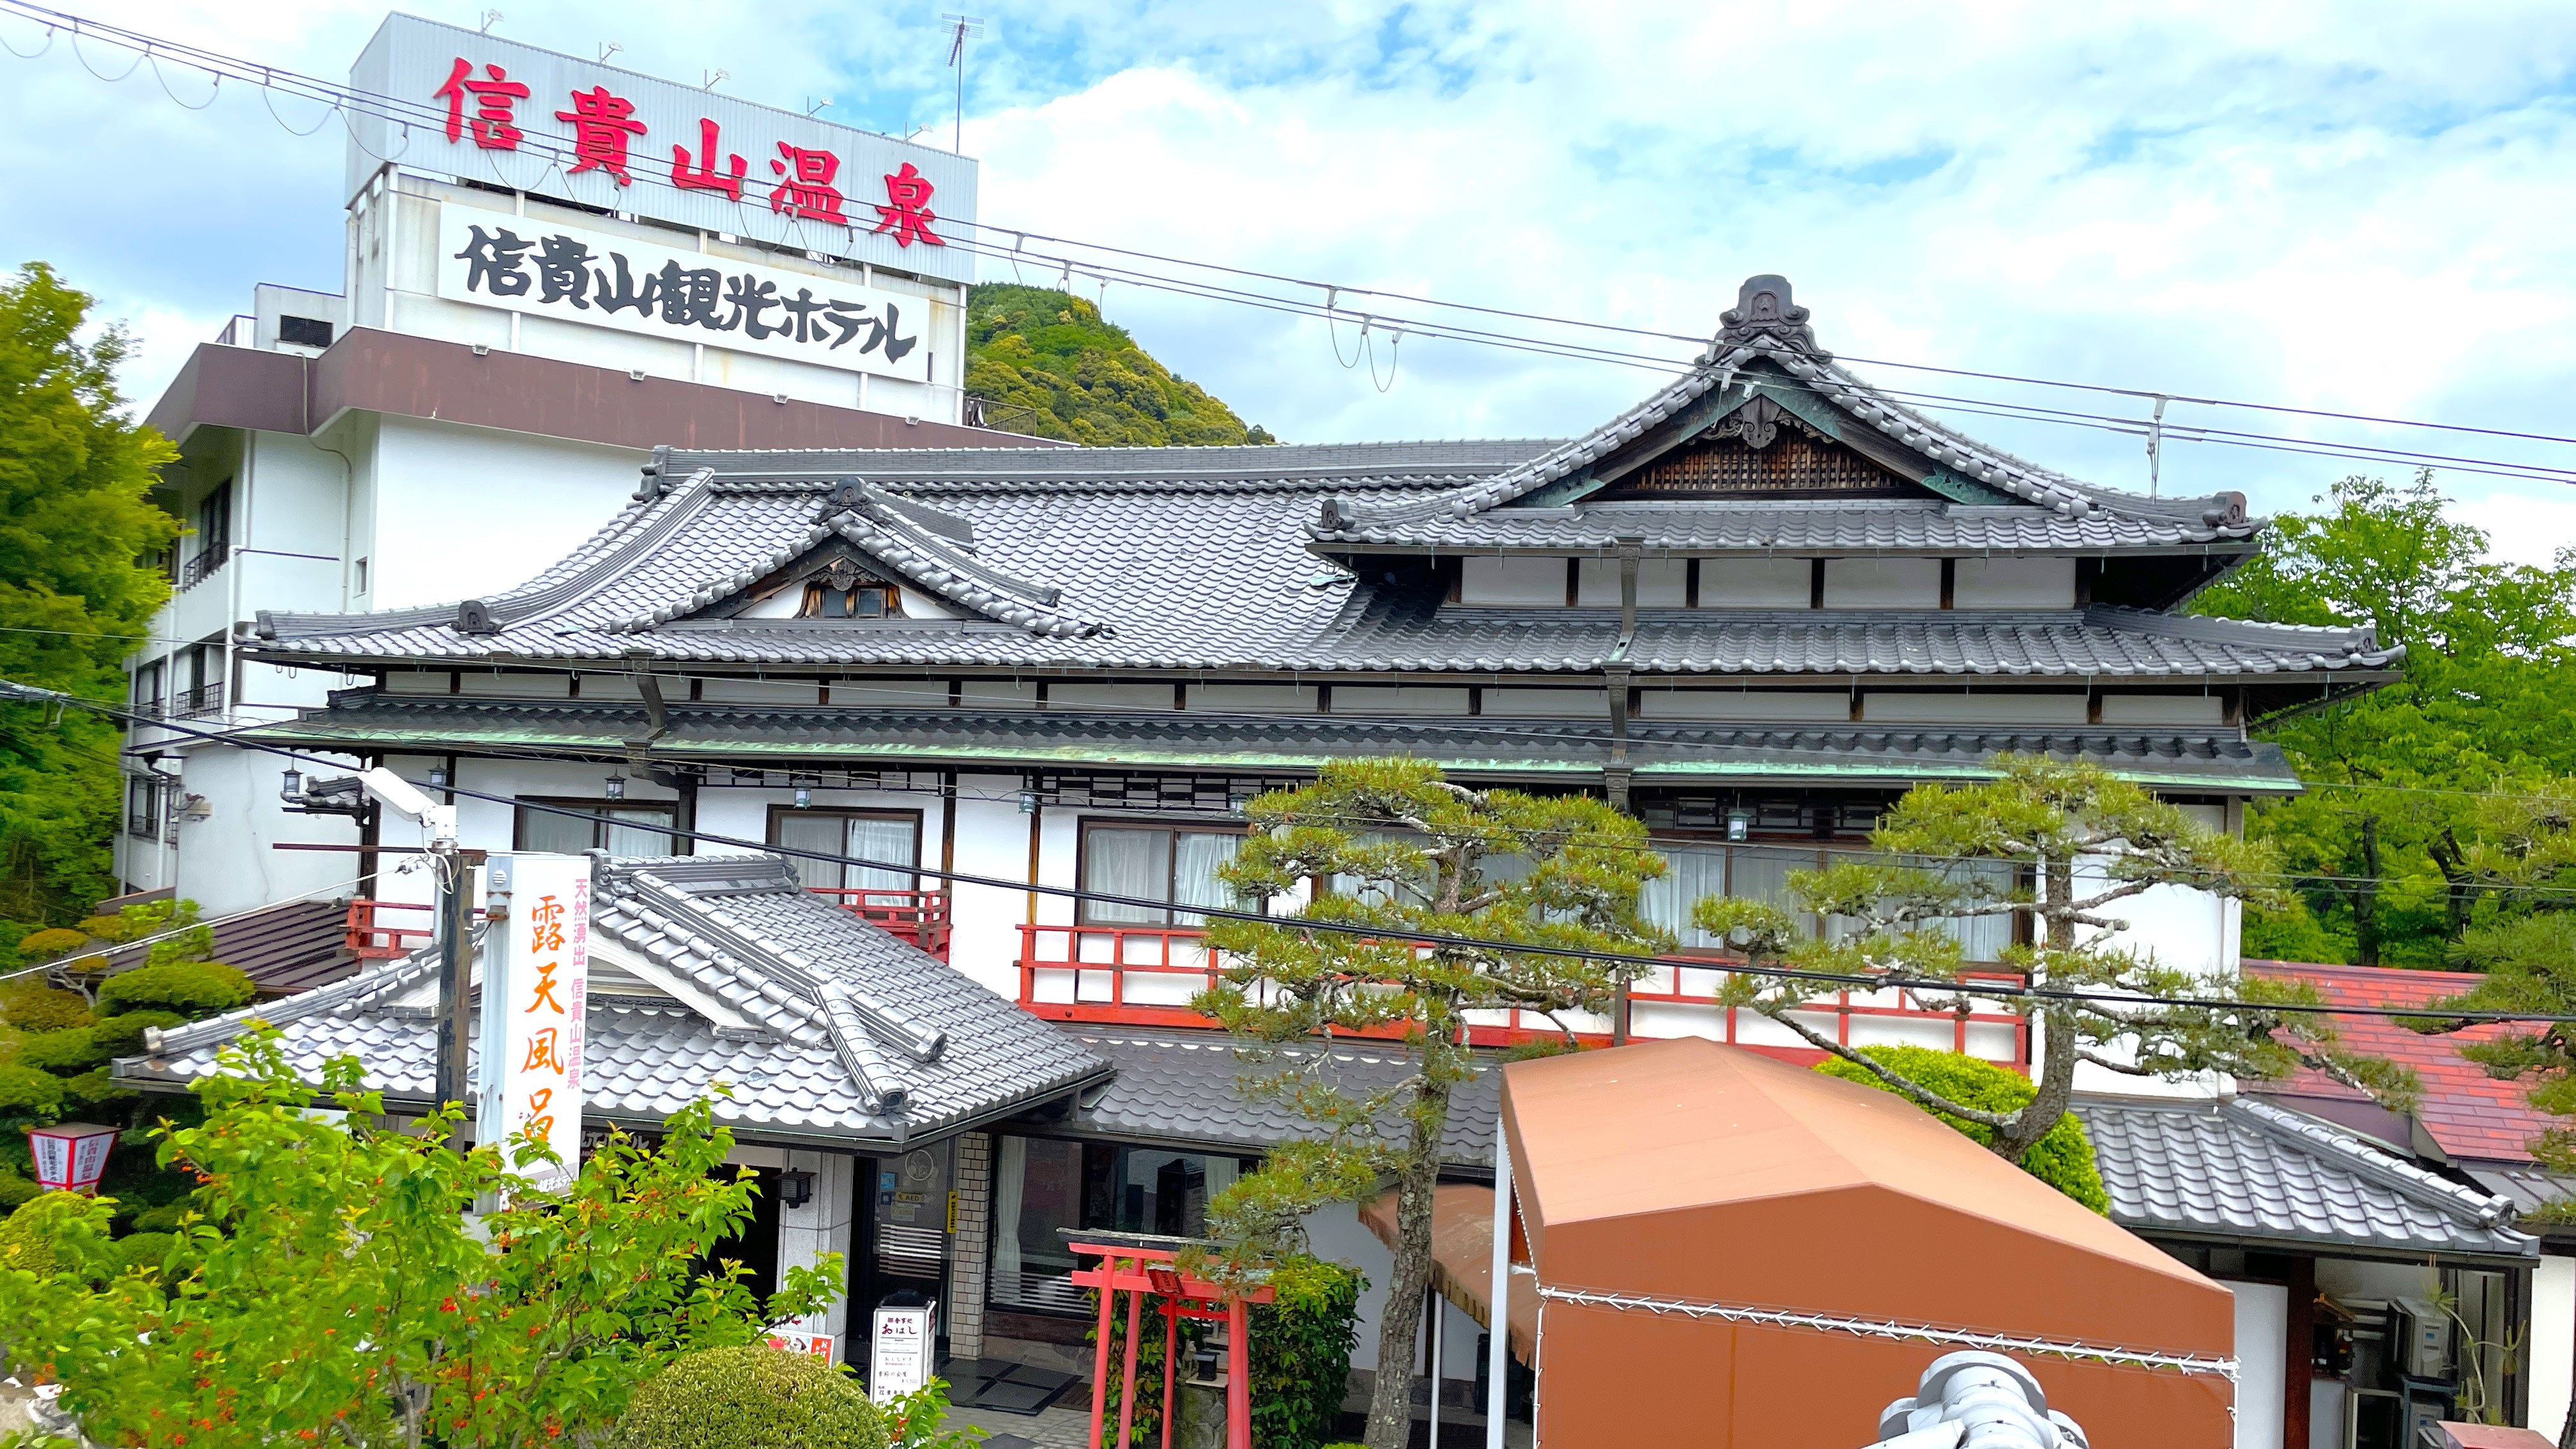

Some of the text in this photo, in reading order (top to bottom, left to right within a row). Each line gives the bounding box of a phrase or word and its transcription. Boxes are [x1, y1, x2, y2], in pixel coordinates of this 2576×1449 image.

[433, 57, 946, 249] 信貴山温泉
[454, 224, 917, 364] 信貴山観光ホテル
[521, 895, 565, 1142] 露天風呂
[567, 878, 588, 1089] 天然湧出 信貴山温泉
[882, 1323, 917, 1335] おはし
